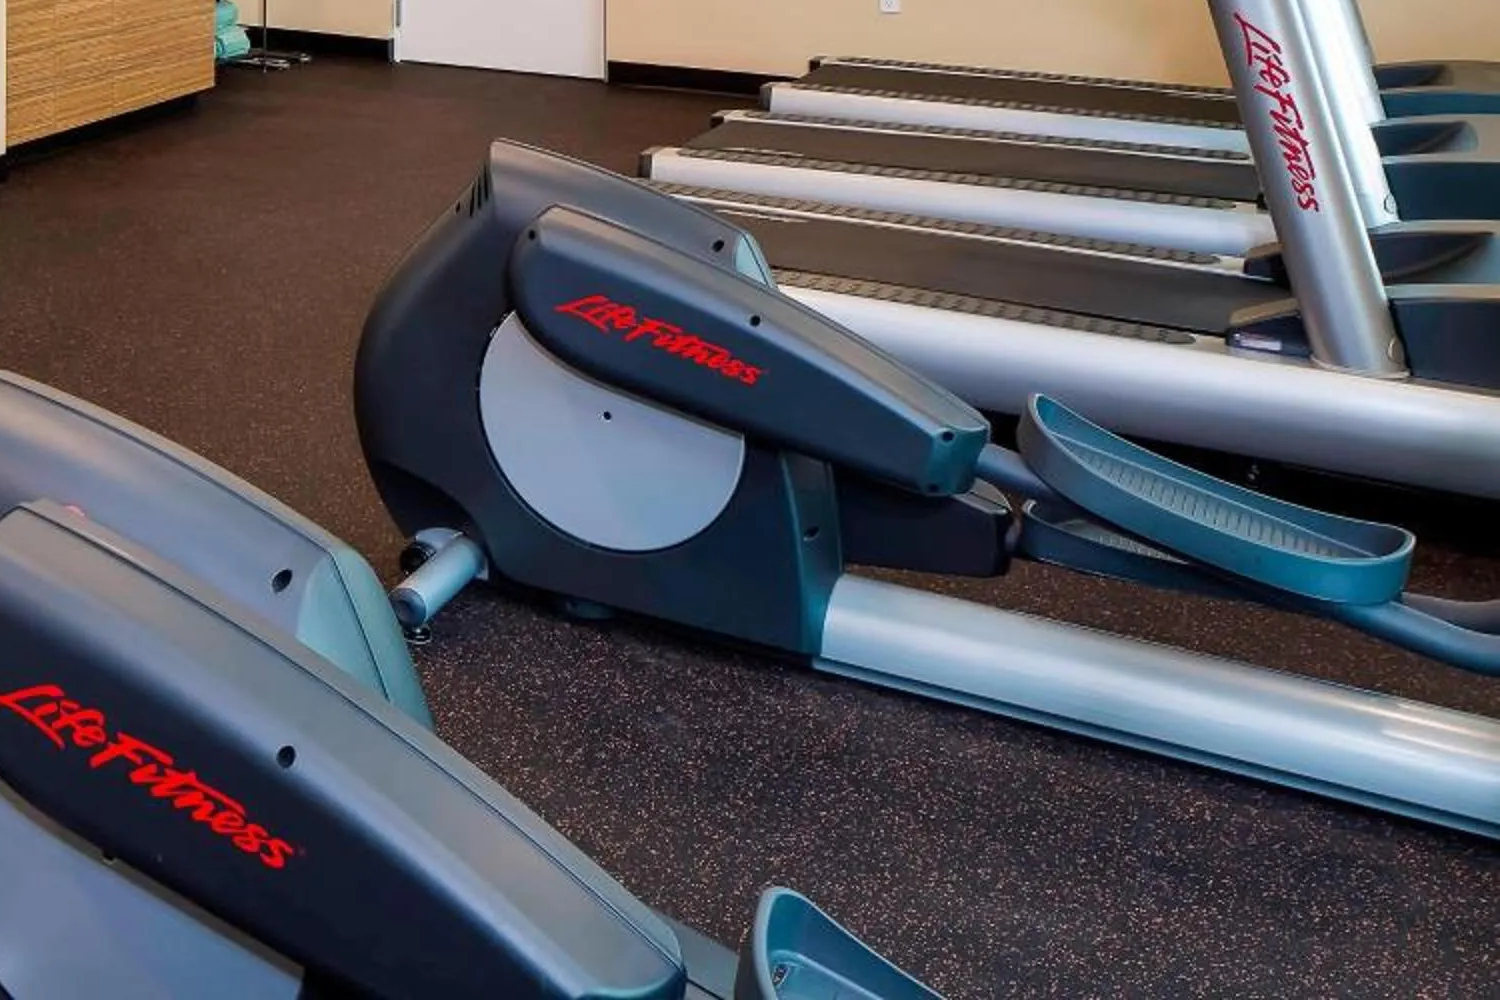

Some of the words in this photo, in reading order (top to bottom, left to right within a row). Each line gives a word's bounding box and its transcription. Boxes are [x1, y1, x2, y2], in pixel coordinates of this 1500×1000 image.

[1234, 11, 1290, 88] Life
[1254, 83, 1320, 213] Fitness
[555, 294, 637, 332] Life
[624, 316, 762, 386] Fitness
[89, 731, 294, 869] Fitness
